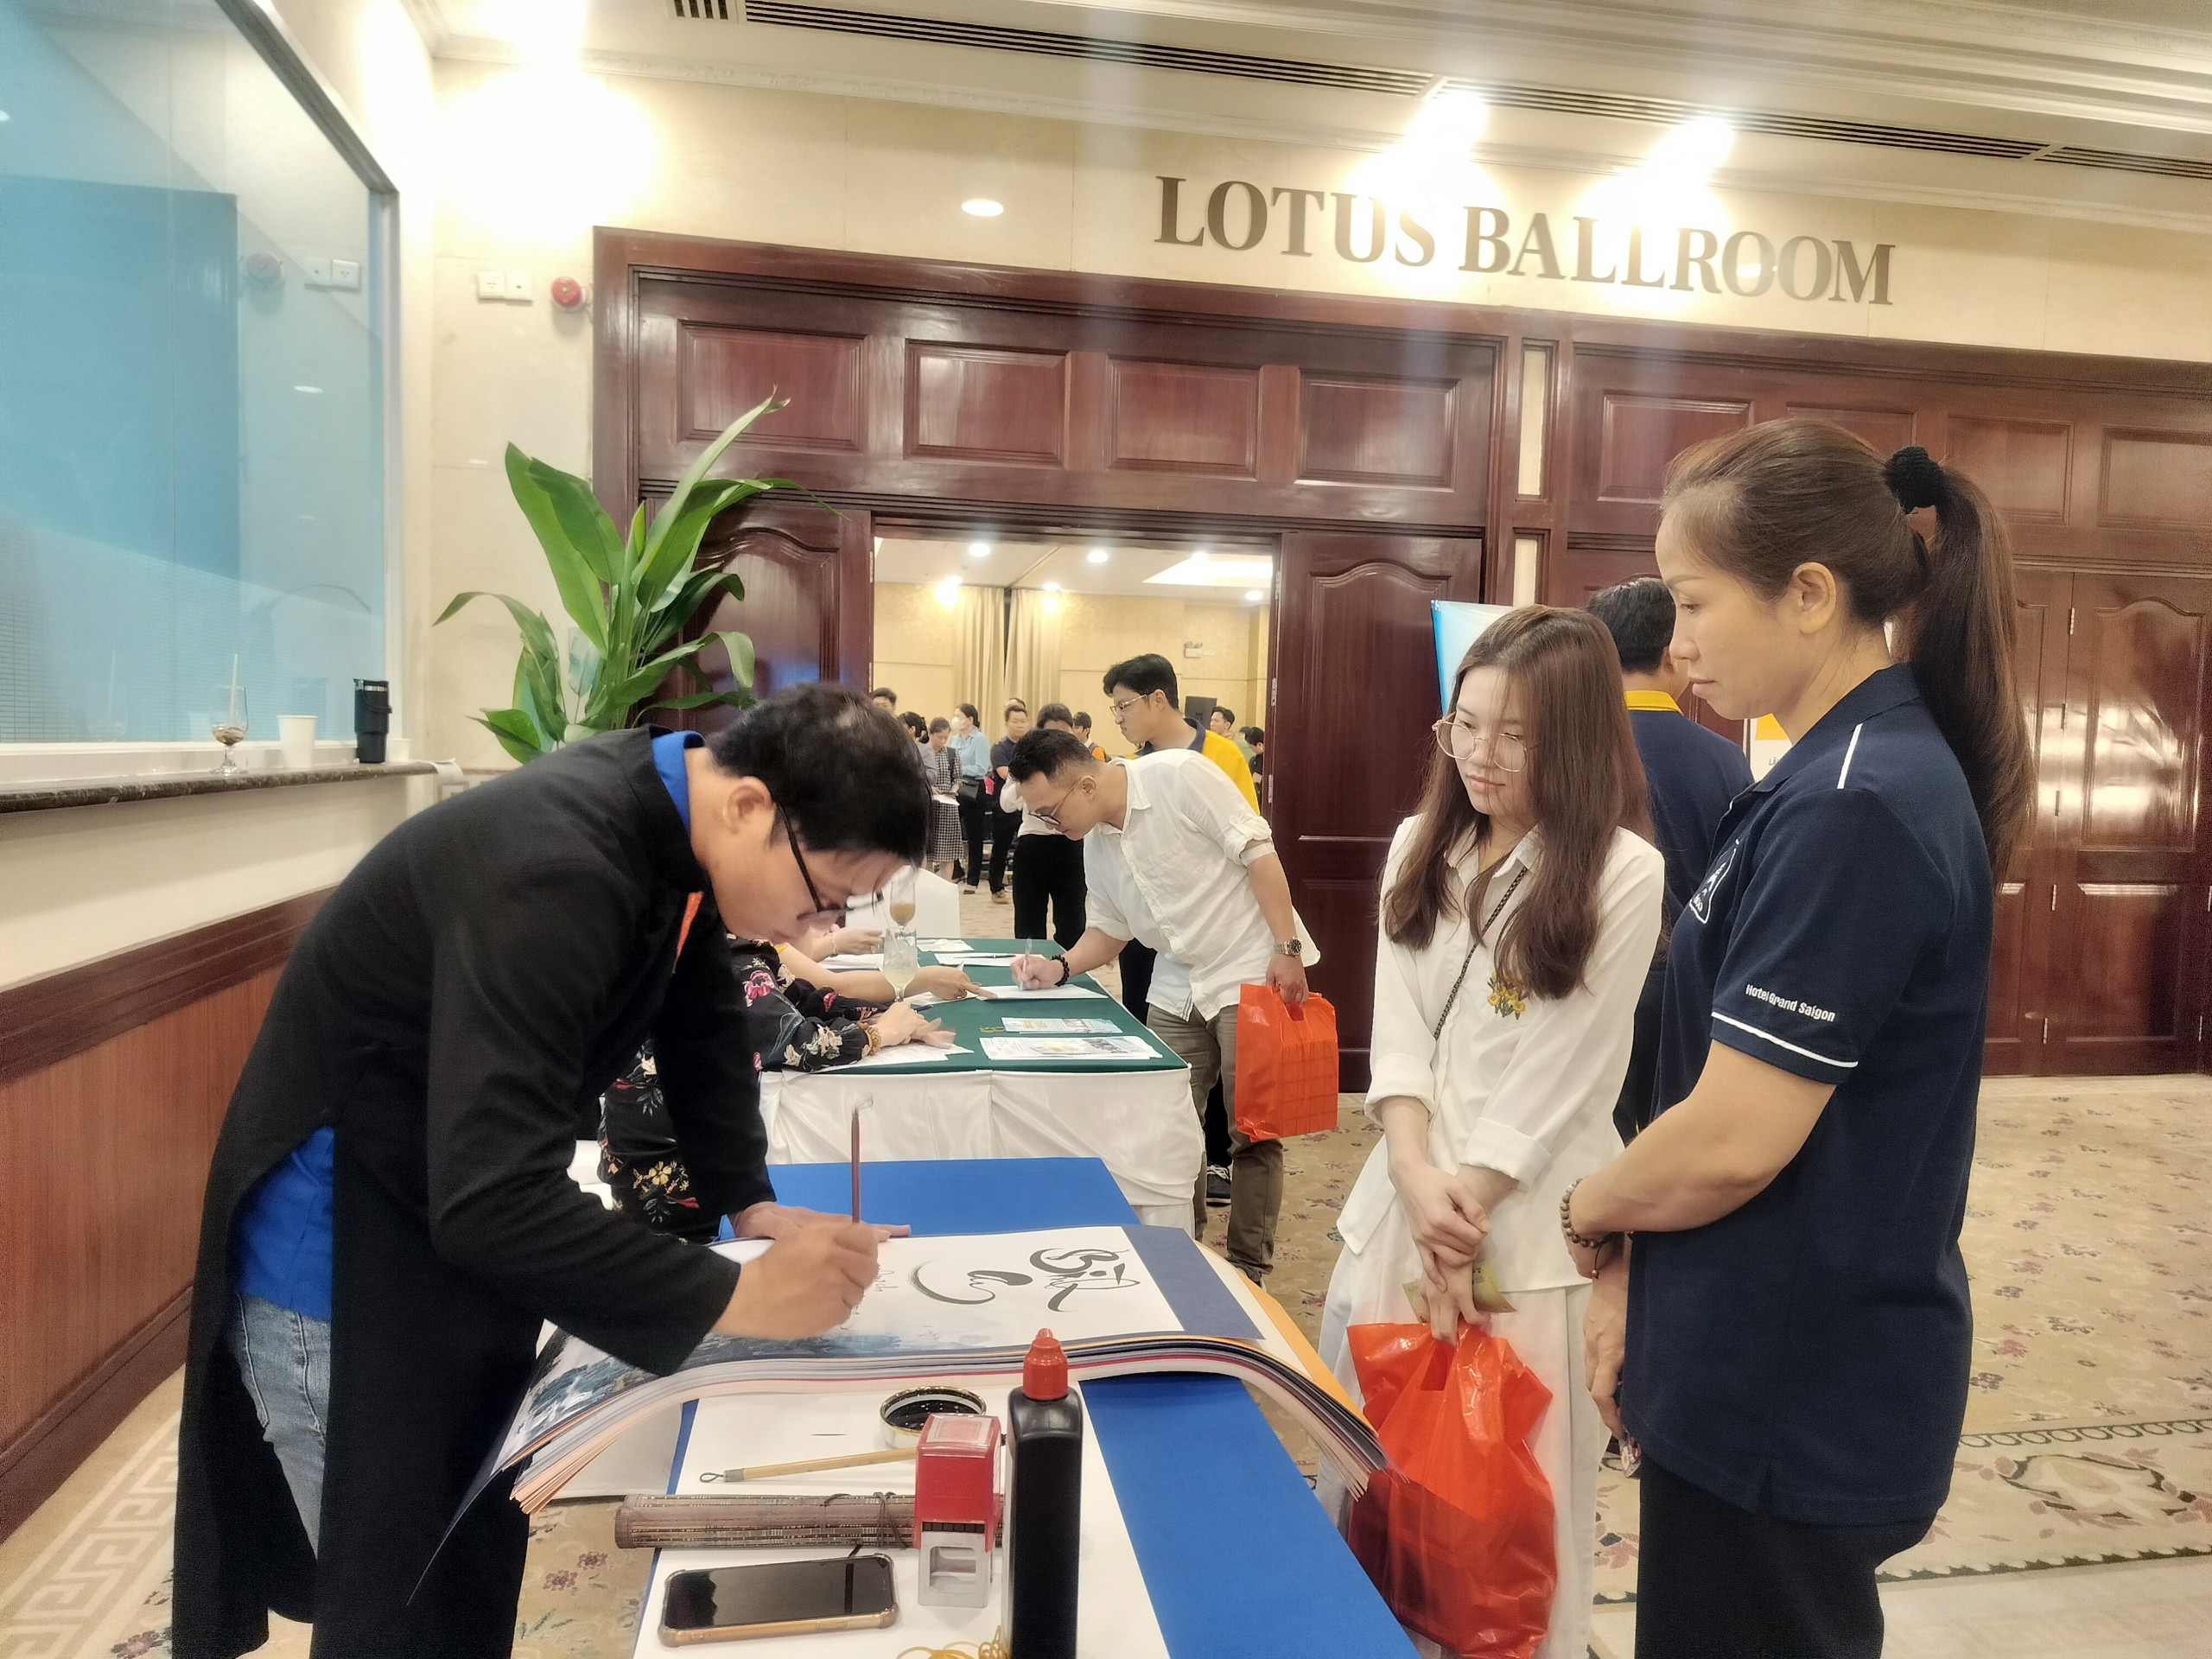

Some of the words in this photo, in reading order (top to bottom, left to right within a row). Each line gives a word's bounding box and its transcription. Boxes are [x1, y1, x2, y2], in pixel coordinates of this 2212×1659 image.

[1154, 175, 1435, 267] LOTUS
[1459, 206, 1896, 305] BALLROOM
[1745, 984, 1770, 1001] Hotel
[1769, 993, 1798, 1011] Grand
[1798, 1002, 1835, 1021] Saigon
